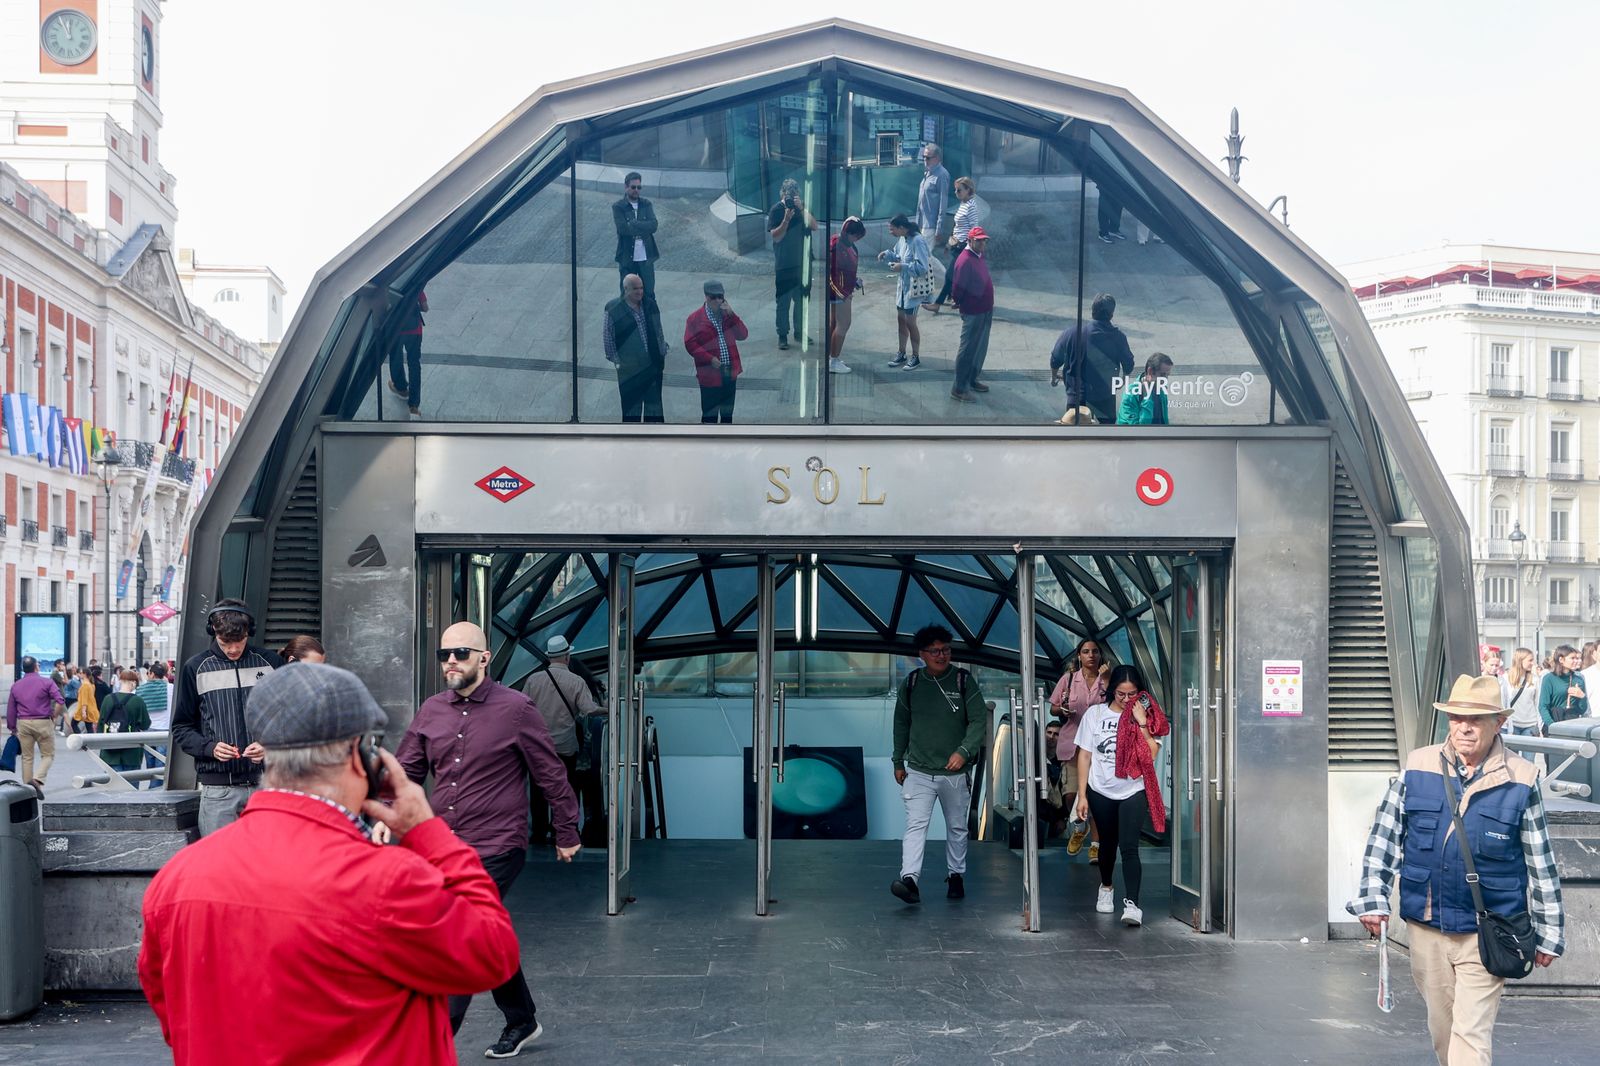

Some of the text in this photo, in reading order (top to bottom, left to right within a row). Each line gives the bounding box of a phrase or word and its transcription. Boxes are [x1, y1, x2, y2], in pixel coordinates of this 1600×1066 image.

[1111, 376, 1214, 400] PlayRenfe
[491, 480, 518, 488] Metro
[766, 465, 887, 505] SOL
